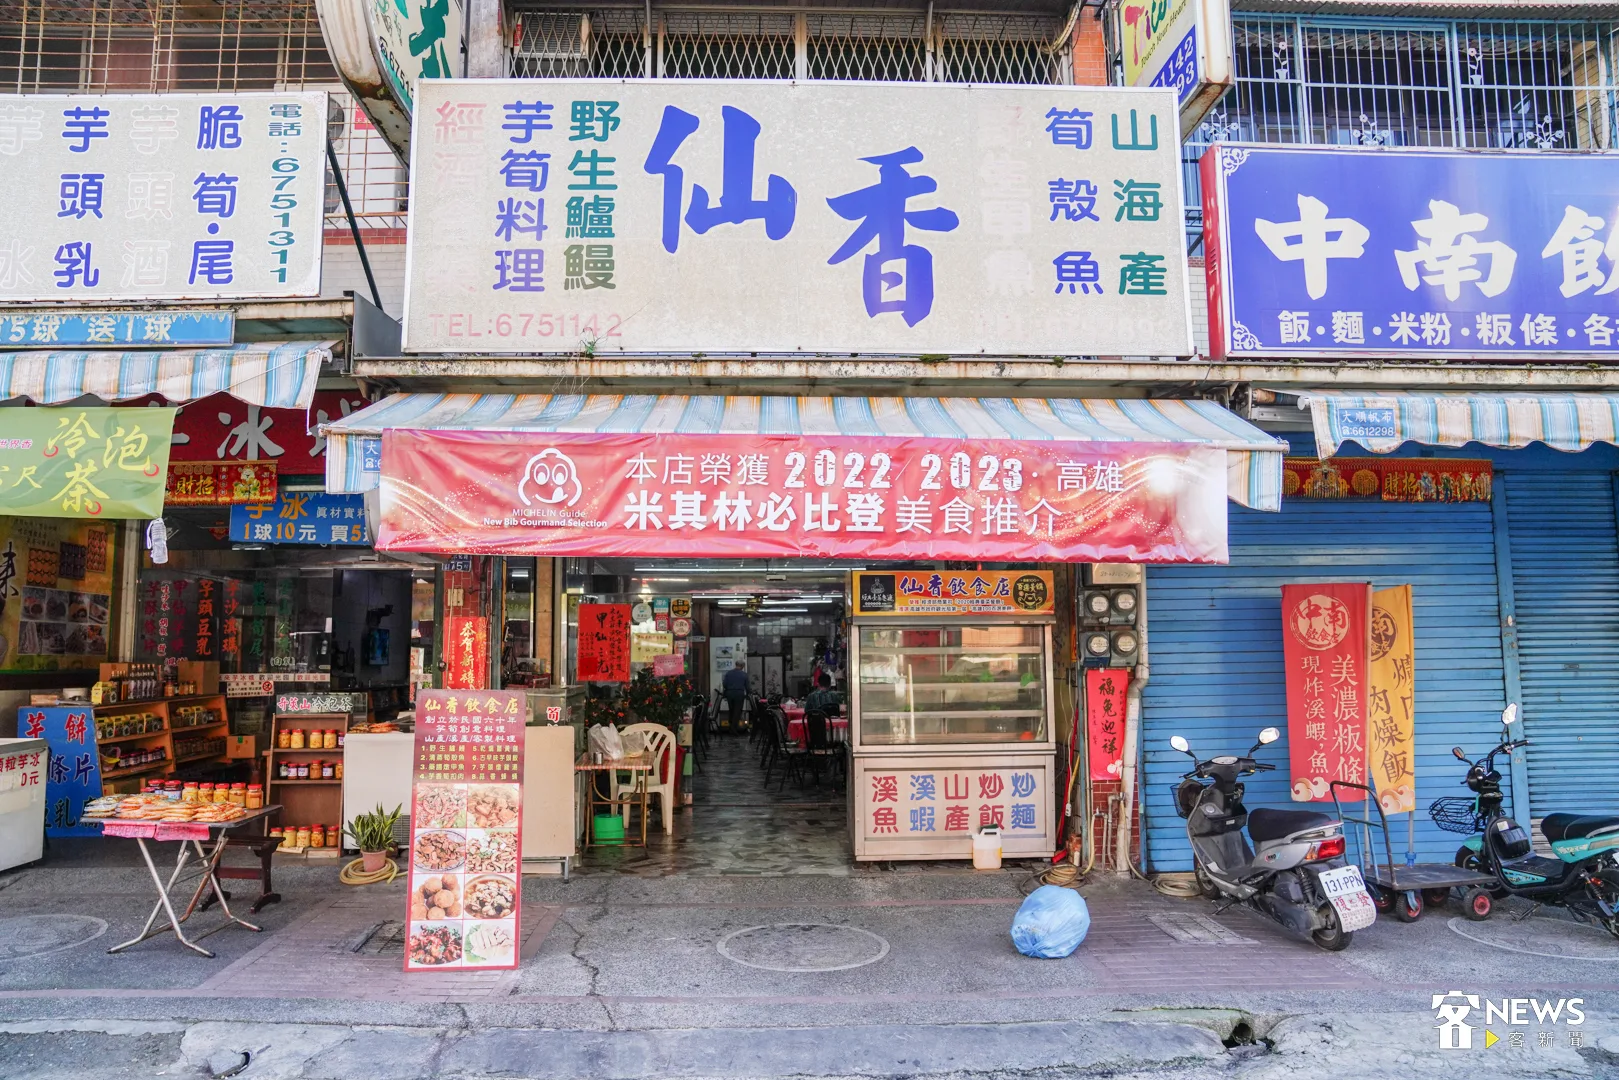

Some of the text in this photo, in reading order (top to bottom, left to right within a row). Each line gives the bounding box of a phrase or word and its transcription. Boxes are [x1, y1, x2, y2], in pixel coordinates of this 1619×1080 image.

[492, 100, 555, 293] 芋筍料理
[563, 100, 621, 291] 野生鱸鰻
[1045, 106, 1104, 295] 筍殼魚
[1111, 108, 1168, 296] 山海產
[624, 452, 769, 486] 本店榮獲
[484, 517, 608, 529] New Bib Gourmand Selection
[512, 508, 586, 518] MICHELIN Guide
[899, 573, 1011, 597] 仙香飲食店
[459, 620, 477, 685] 恭賀新禧
[424, 696, 519, 715] 仙香飲食店
[871, 775, 899, 833] 溪魚
[909, 774, 936, 832] 溪蝦
[944, 773, 970, 831] 山產
[1010, 772, 1037, 829] 炒麵
[1324, 874, 1364, 893] 131-PPN
